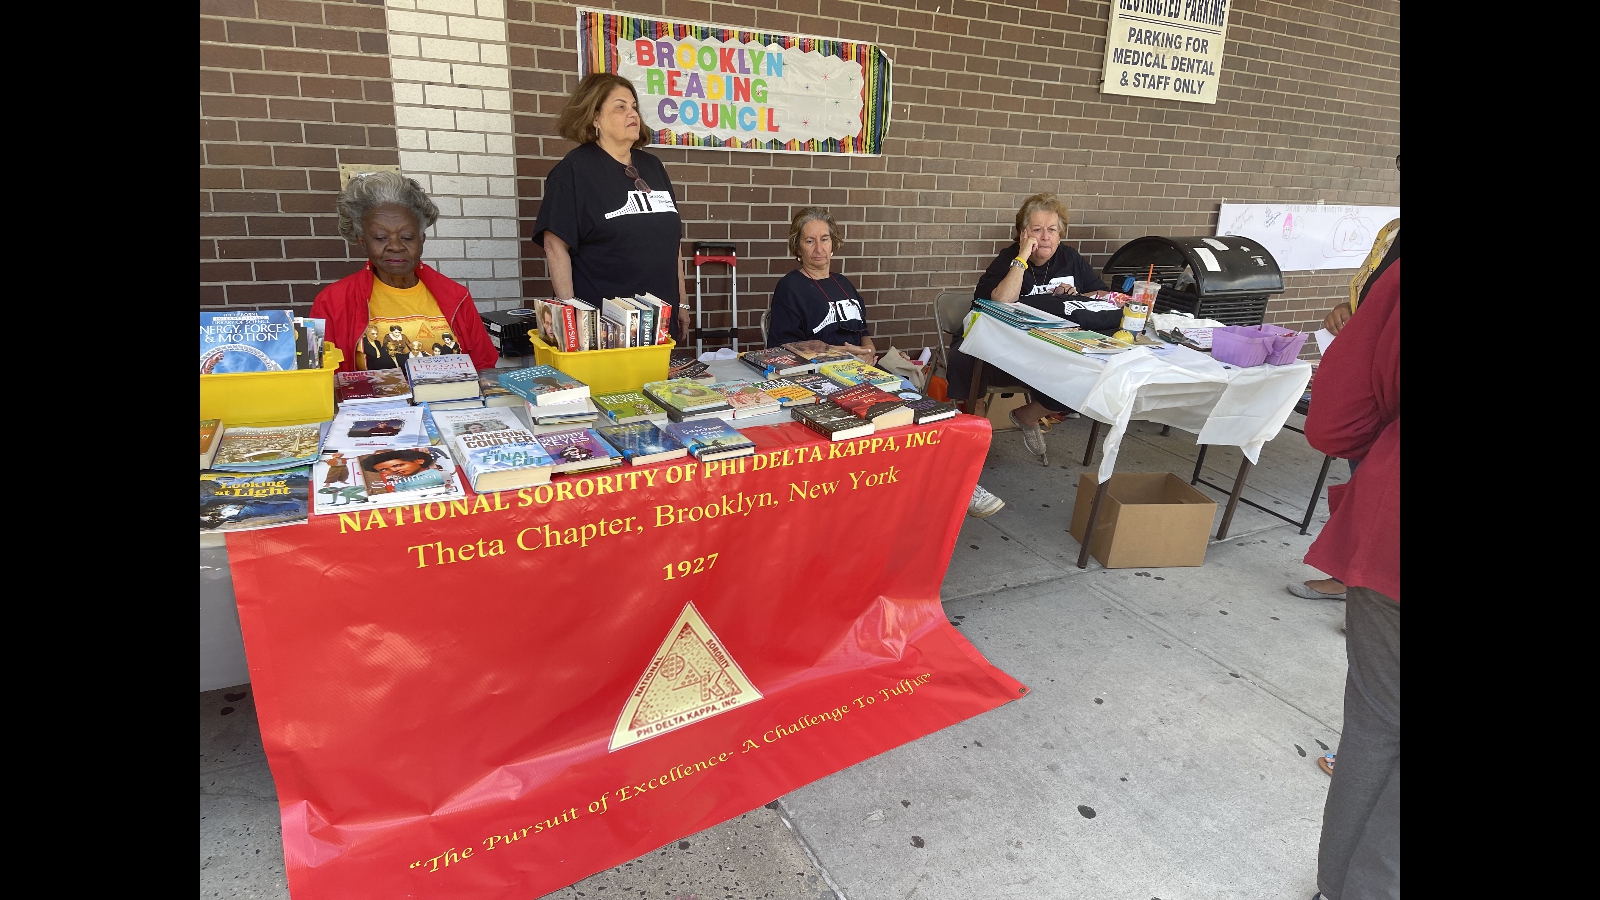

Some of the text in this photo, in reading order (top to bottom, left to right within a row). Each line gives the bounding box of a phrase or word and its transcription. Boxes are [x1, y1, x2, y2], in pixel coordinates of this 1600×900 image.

[1184, 0, 1226, 27] PARKING
[1127, 26, 1209, 54] PARKING FOR
[635, 39, 783, 77] BROOKLYN
[1112, 47, 1216, 77] MEDICAL DENTAL
[647, 69, 768, 103] READING
[1119, 70, 1206, 95] & STAFF ONLY
[658, 98, 779, 132] COUNCIL
[204, 332, 279, 343] & MOTION
[244, 323, 290, 334] FORCES
[462, 431, 529, 442] CATHERINE
[466, 436, 535, 449] COULTER
[543, 436, 590, 448] KEYES
[482, 450, 530, 463] FINAL
[512, 456, 544, 467] CUT
[220, 480, 288, 489] Looking
[233, 486, 292, 498] Light
[338, 429, 942, 535] NATIONAL SORORITY OF PHI DELTA KAPPA, INC.
[407, 465, 902, 569] Theta Chapter, Brooklyn, New York
[662, 552, 720, 582] 1927
[705, 638, 731, 669] SORORITY
[634, 655, 665, 698] NATIONAL
[636, 696, 741, 738] PHI DELTA KAPPA, INC.
[482, 806, 580, 852] Pursuit
[587, 791, 610, 814] of
[615, 751, 734, 803] Excellence-
[741, 739, 760, 754] A
[763, 704, 851, 744] Challenge
[852, 694, 876, 709] To
